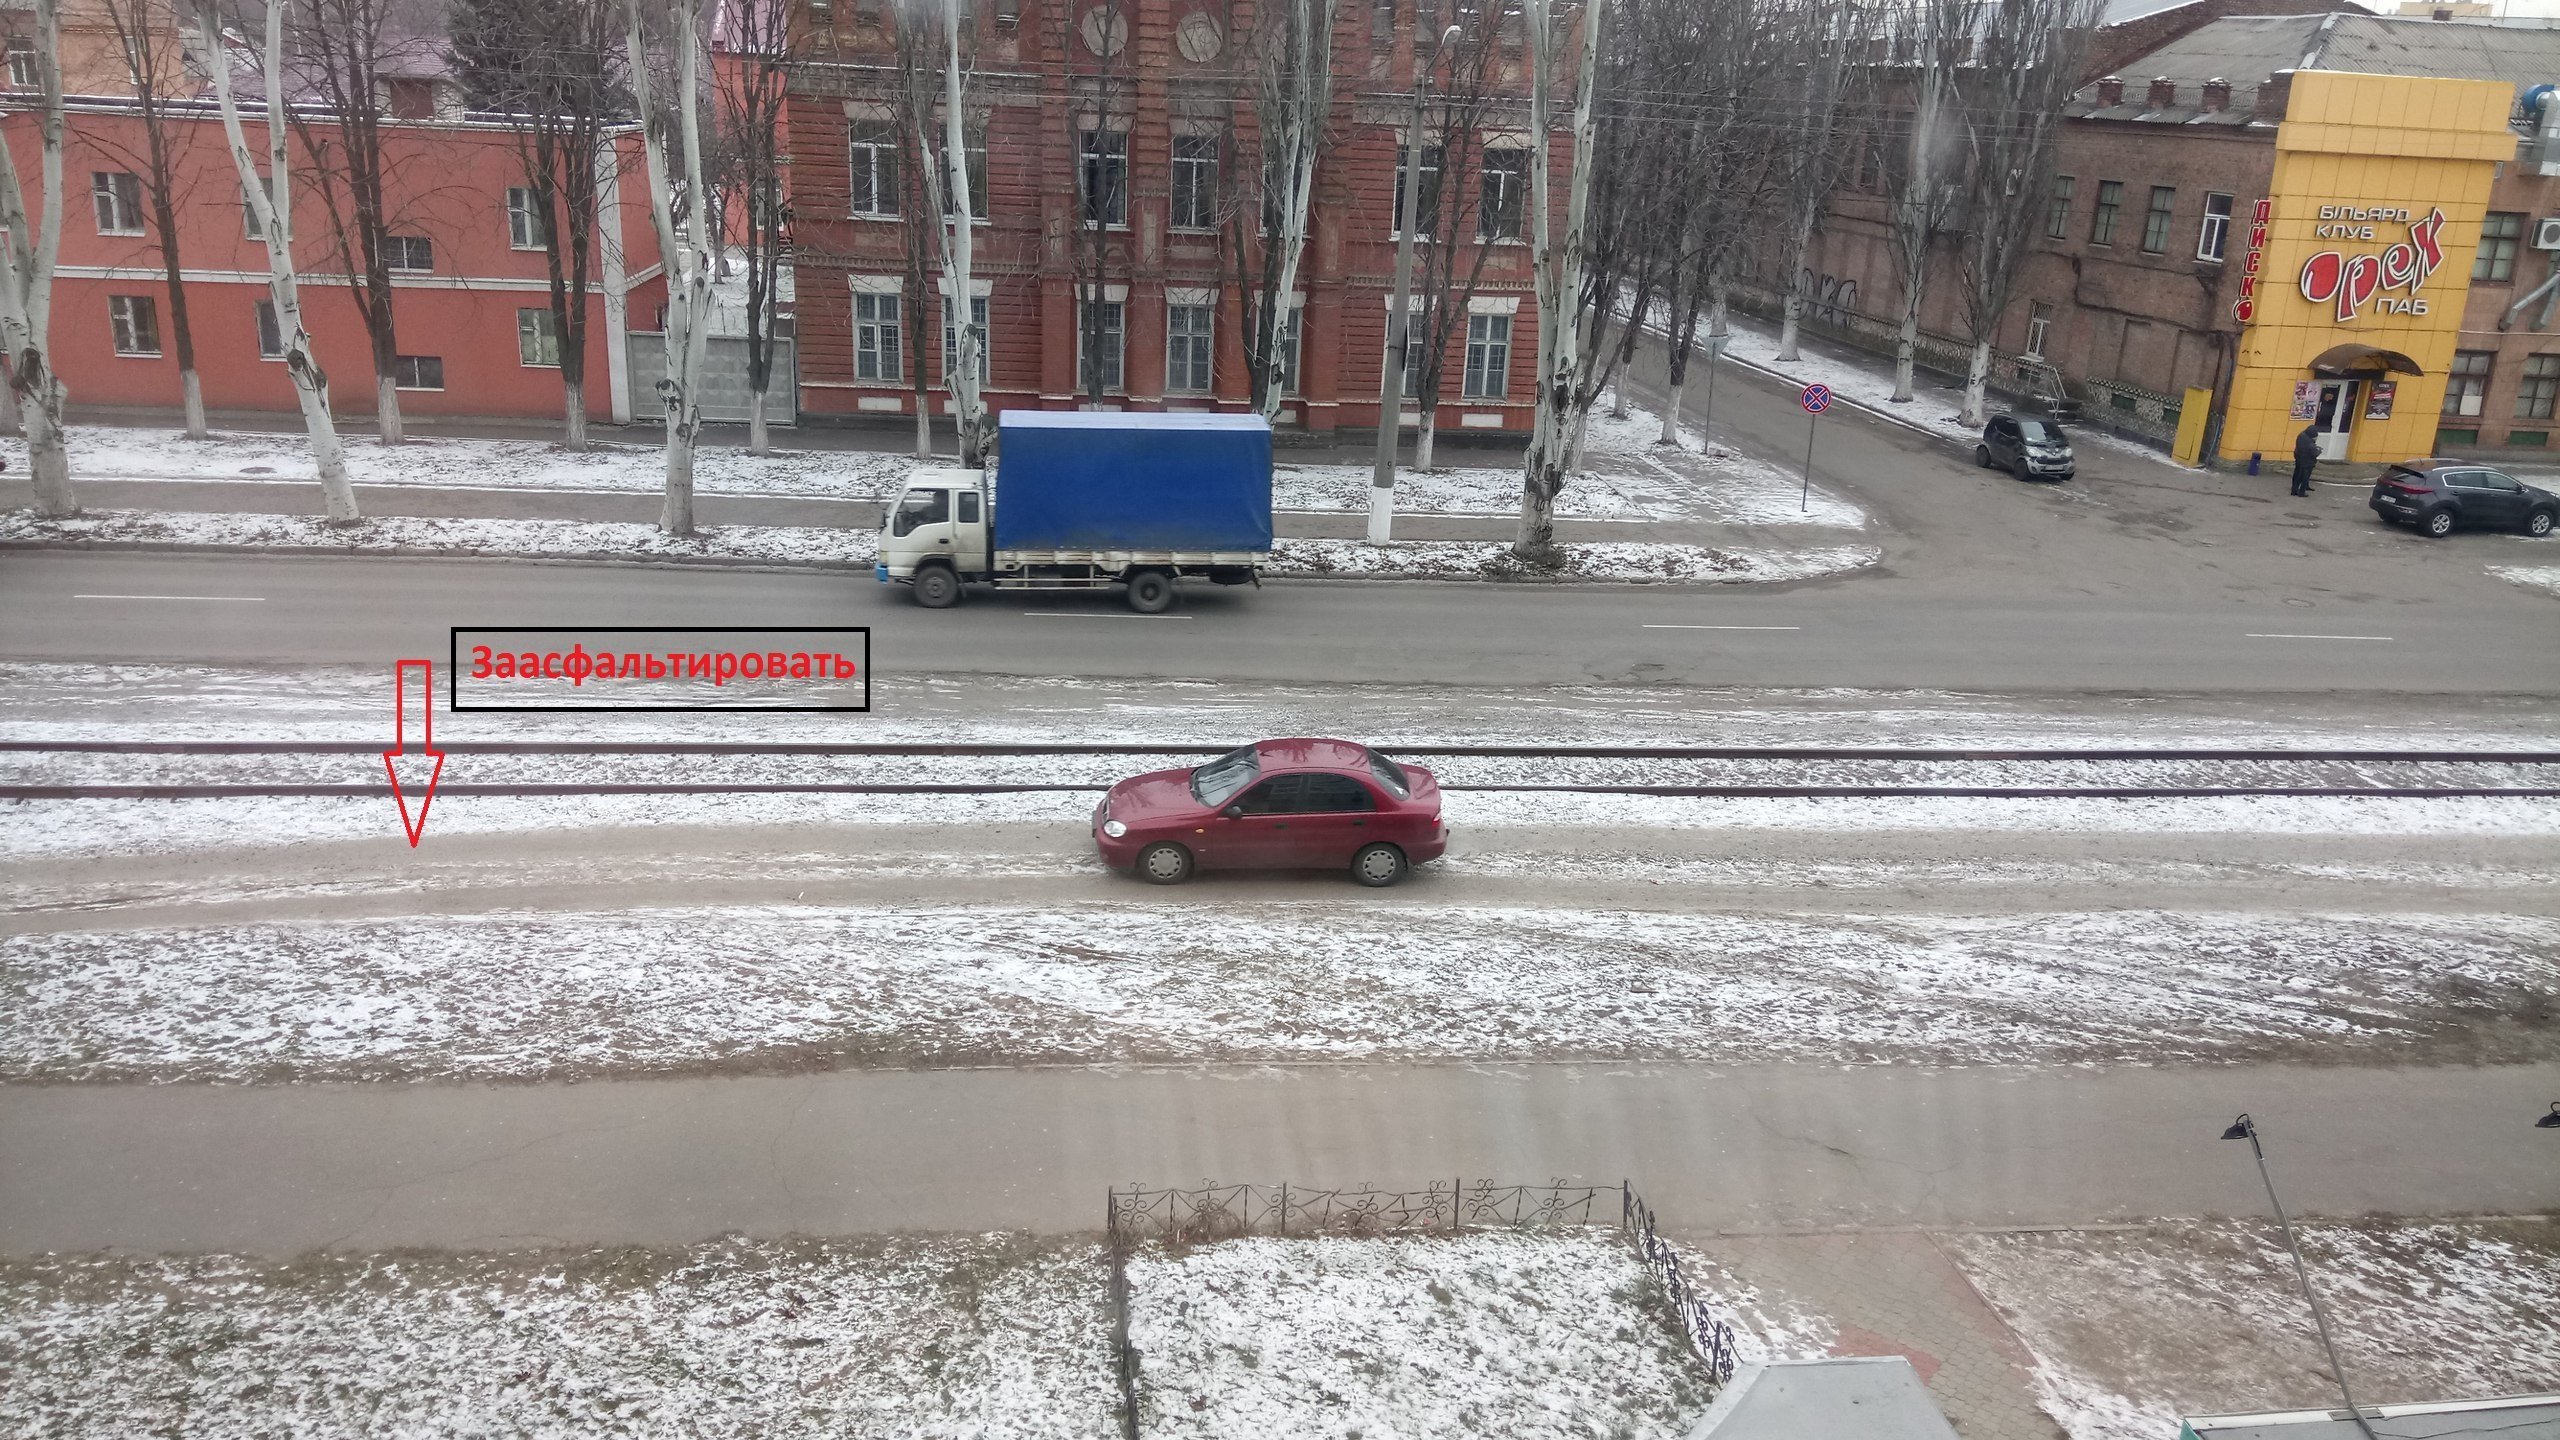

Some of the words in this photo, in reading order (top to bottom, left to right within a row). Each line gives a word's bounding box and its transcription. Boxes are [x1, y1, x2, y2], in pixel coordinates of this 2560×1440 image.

[2319, 205, 2410, 222] БІЛЬЯРД
[2315, 224, 2375, 240] КЛУБ
[2233, 199, 2272, 322] ДИСКО
[2375, 298, 2430, 316] ПАБ
